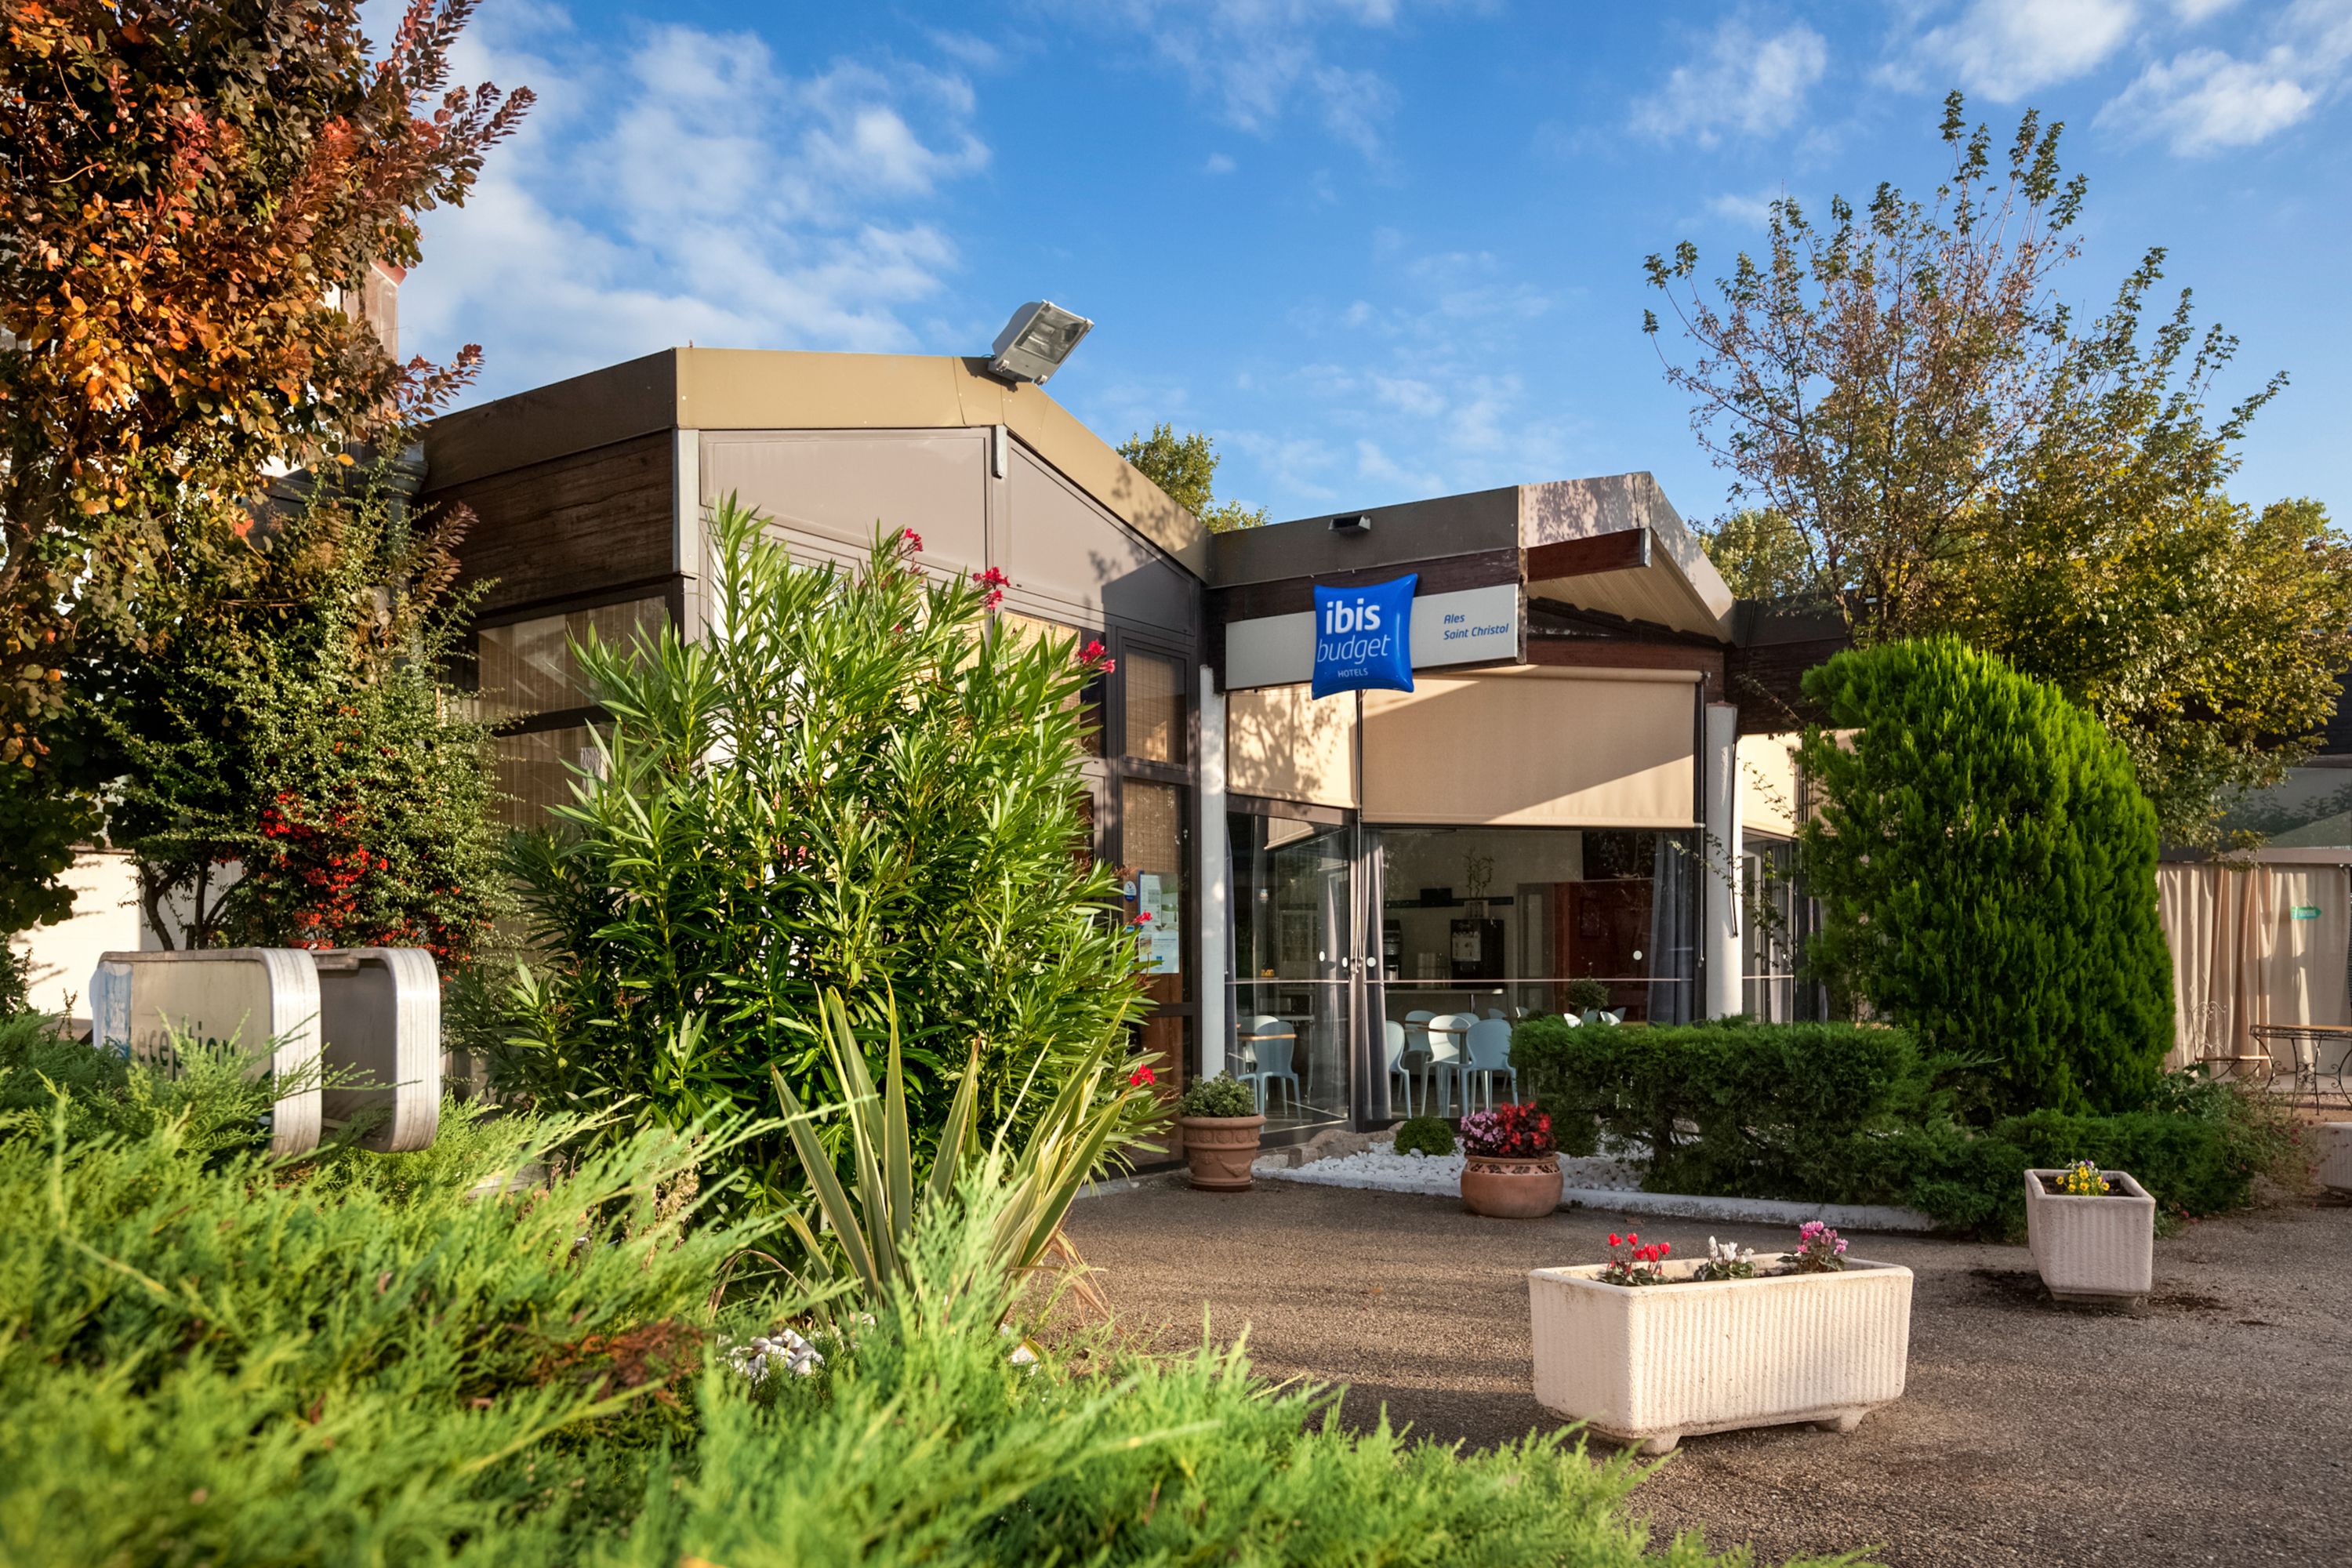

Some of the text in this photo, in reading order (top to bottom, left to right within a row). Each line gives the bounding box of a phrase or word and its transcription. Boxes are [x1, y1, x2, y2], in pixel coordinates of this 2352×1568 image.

[1326, 597, 1381, 634] ibis
[1443, 614, 1465, 624] Ales
[1443, 622, 1509, 640] Saint Christol
[1317, 634, 1391, 665] budget
[1338, 667, 1369, 678] HOTELS
